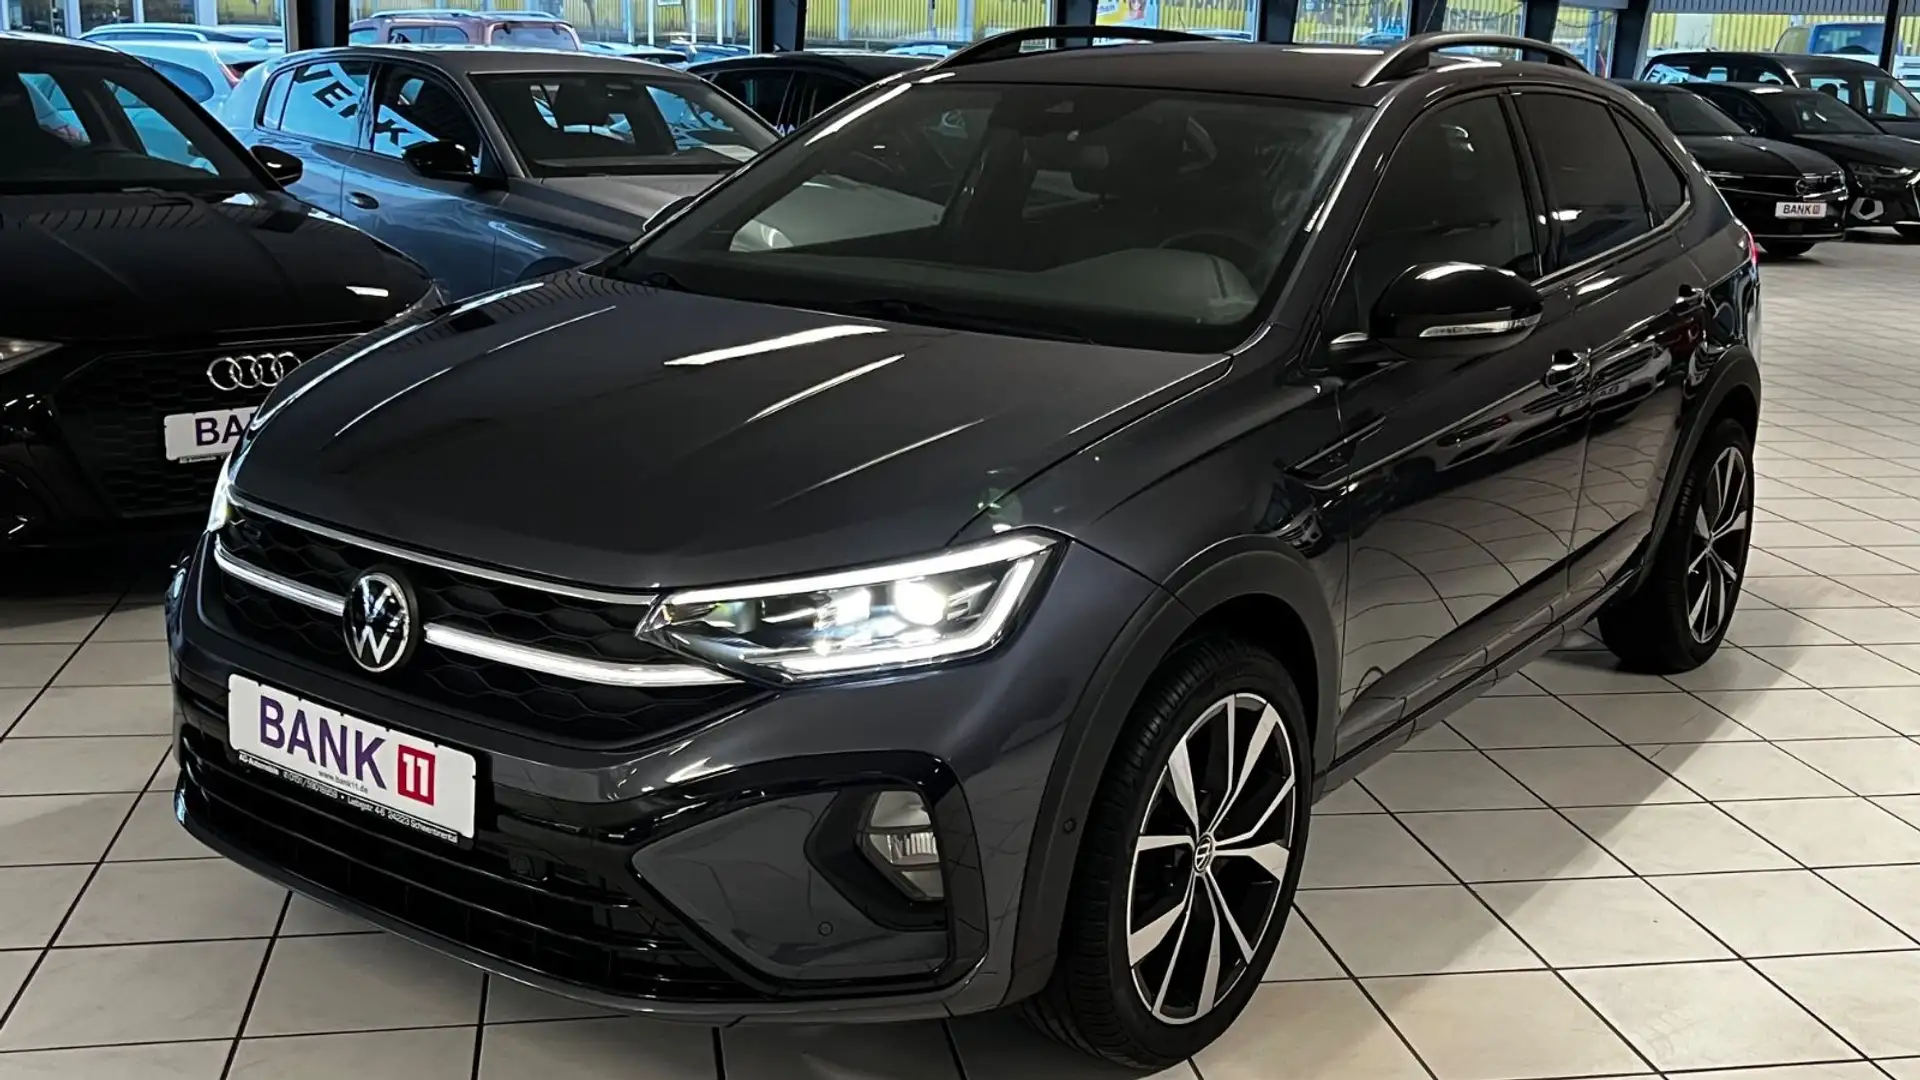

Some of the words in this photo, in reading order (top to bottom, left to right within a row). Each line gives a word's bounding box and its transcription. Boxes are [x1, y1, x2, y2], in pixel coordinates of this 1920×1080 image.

[1783, 204, 1811, 214] BANK
[195, 413, 255, 446] BA
[260, 695, 387, 790] BANK
[402, 752, 430, 798] 11
